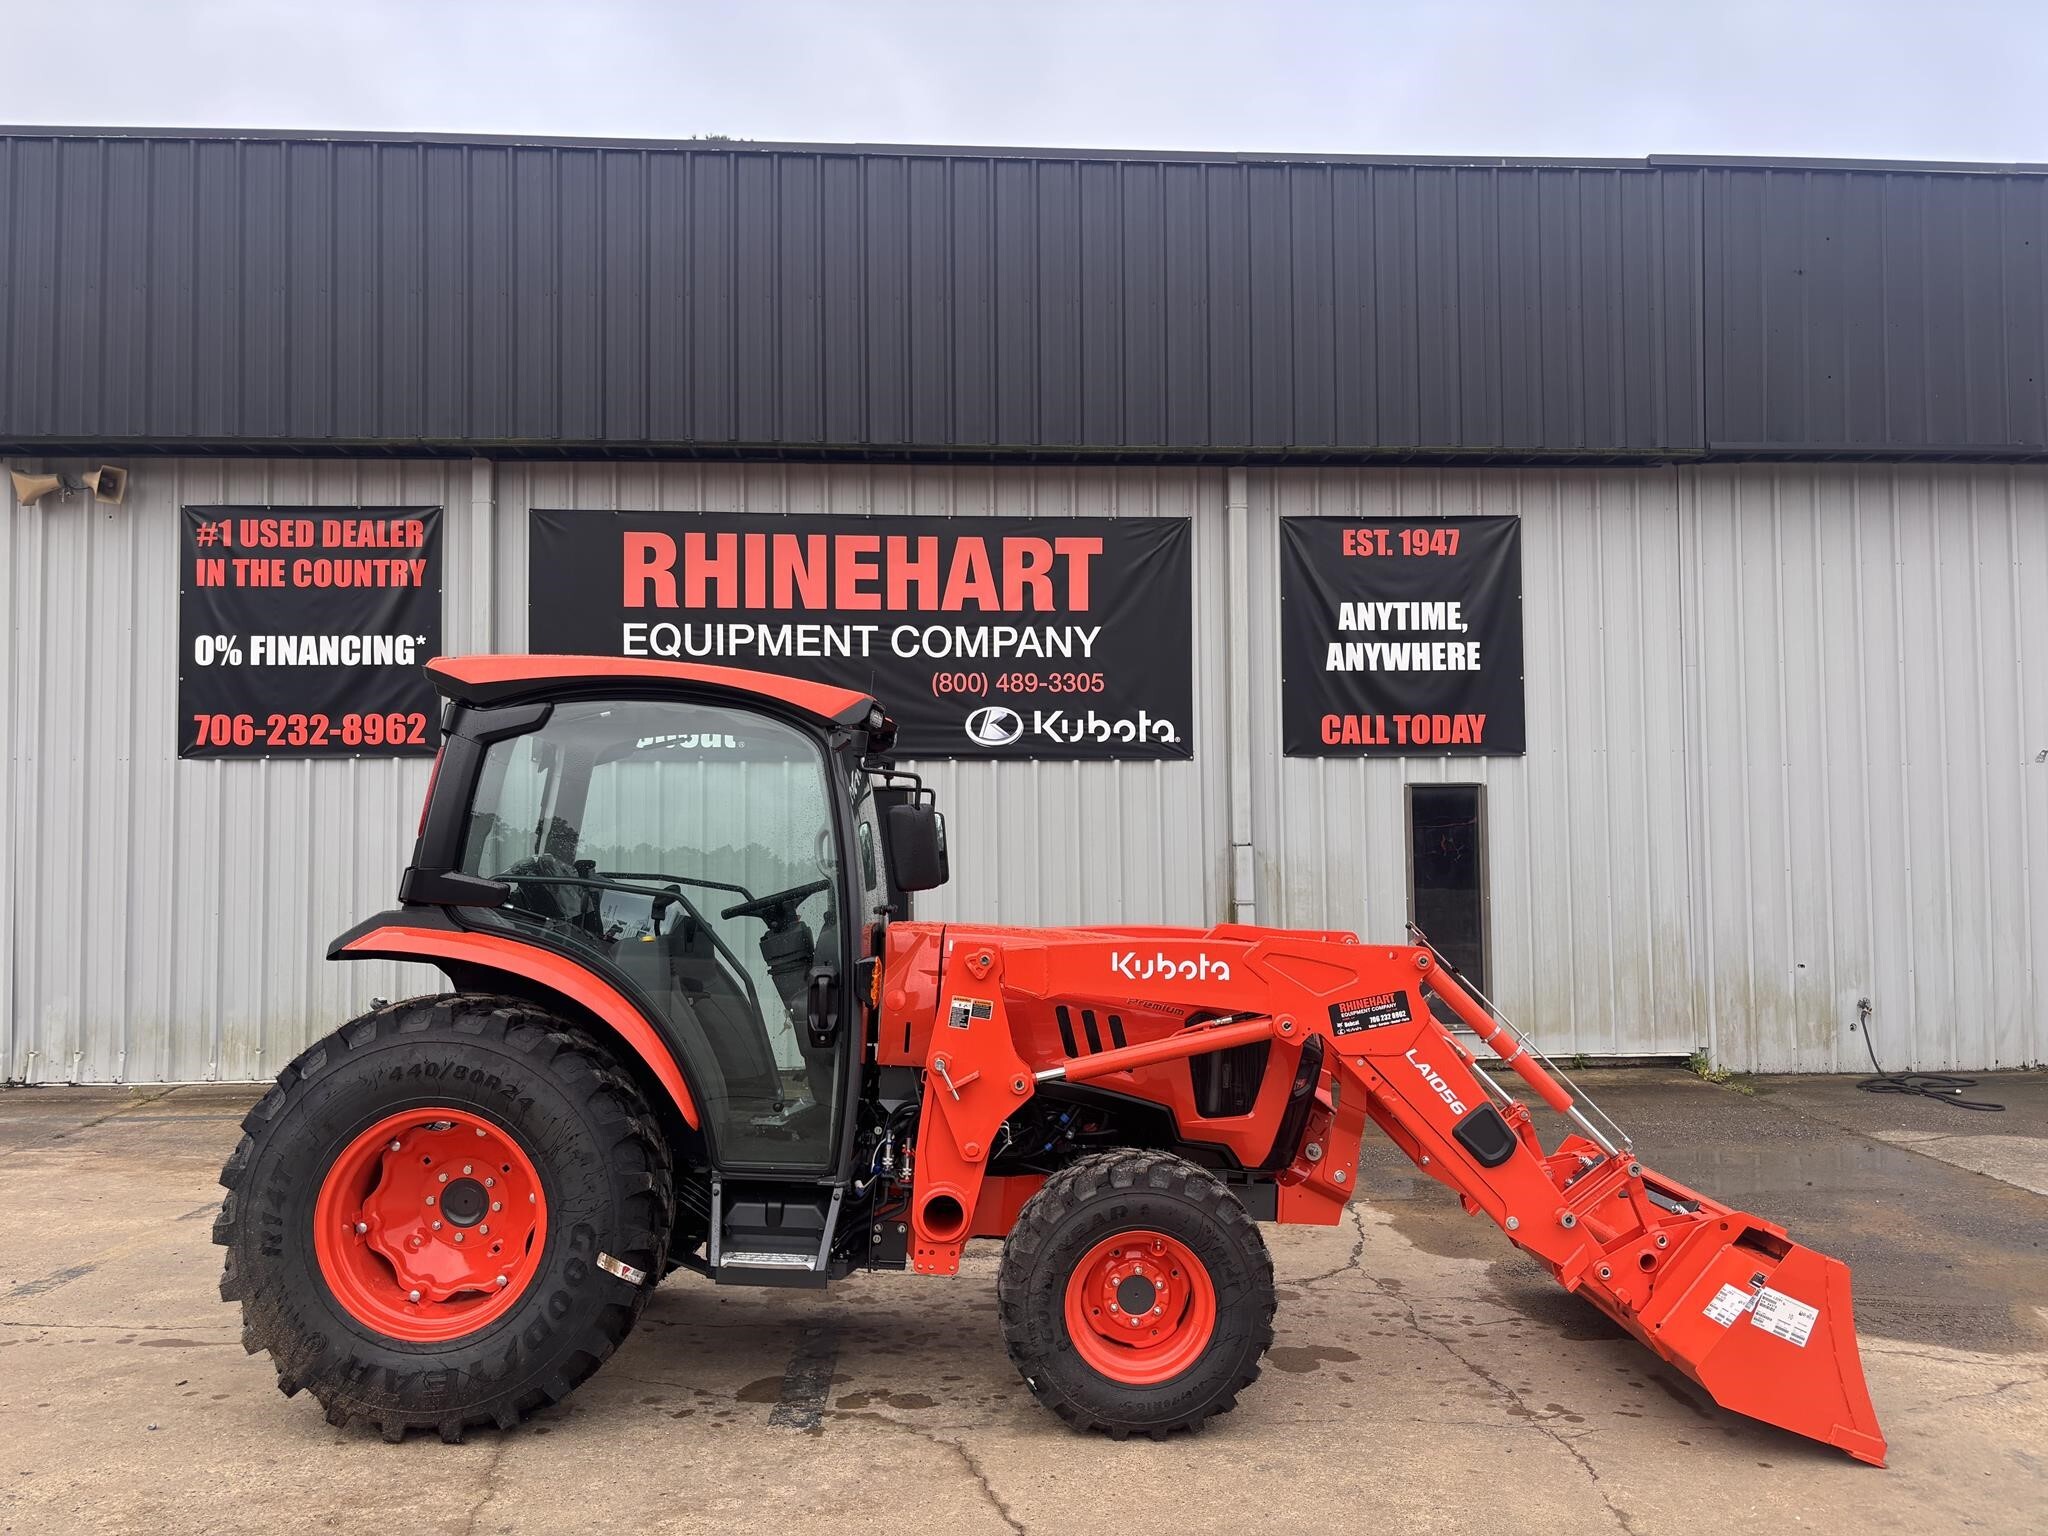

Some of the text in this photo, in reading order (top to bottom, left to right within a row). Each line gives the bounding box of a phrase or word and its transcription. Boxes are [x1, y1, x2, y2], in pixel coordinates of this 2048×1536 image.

[197, 519, 423, 547] #1 USED DEALER
[1343, 529, 1459, 556] EST. 1947
[197, 559, 426, 587] IN THE COUNTRY
[624, 532, 1103, 611] RHINEHART
[1339, 602, 1468, 633] ANYTIME,
[195, 635, 242, 665] 0%
[623, 622, 1101, 658] EQUIPMENT COMPANY
[1326, 642, 1480, 671] ANYWHERE
[933, 672, 1104, 697] (800) 489-3305
[194, 713, 426, 746] 706-232-8962
[1322, 714, 1486, 744] CALL TODAY
[1112, 952, 1229, 981] Kubota
[1127, 998, 1184, 1016] Premium
[1339, 993, 1395, 1013] RHINEHART
[1341, 1002, 1397, 1018] EQUIPMENT COMPANY
[1405, 1048, 1468, 1116] LA1056
